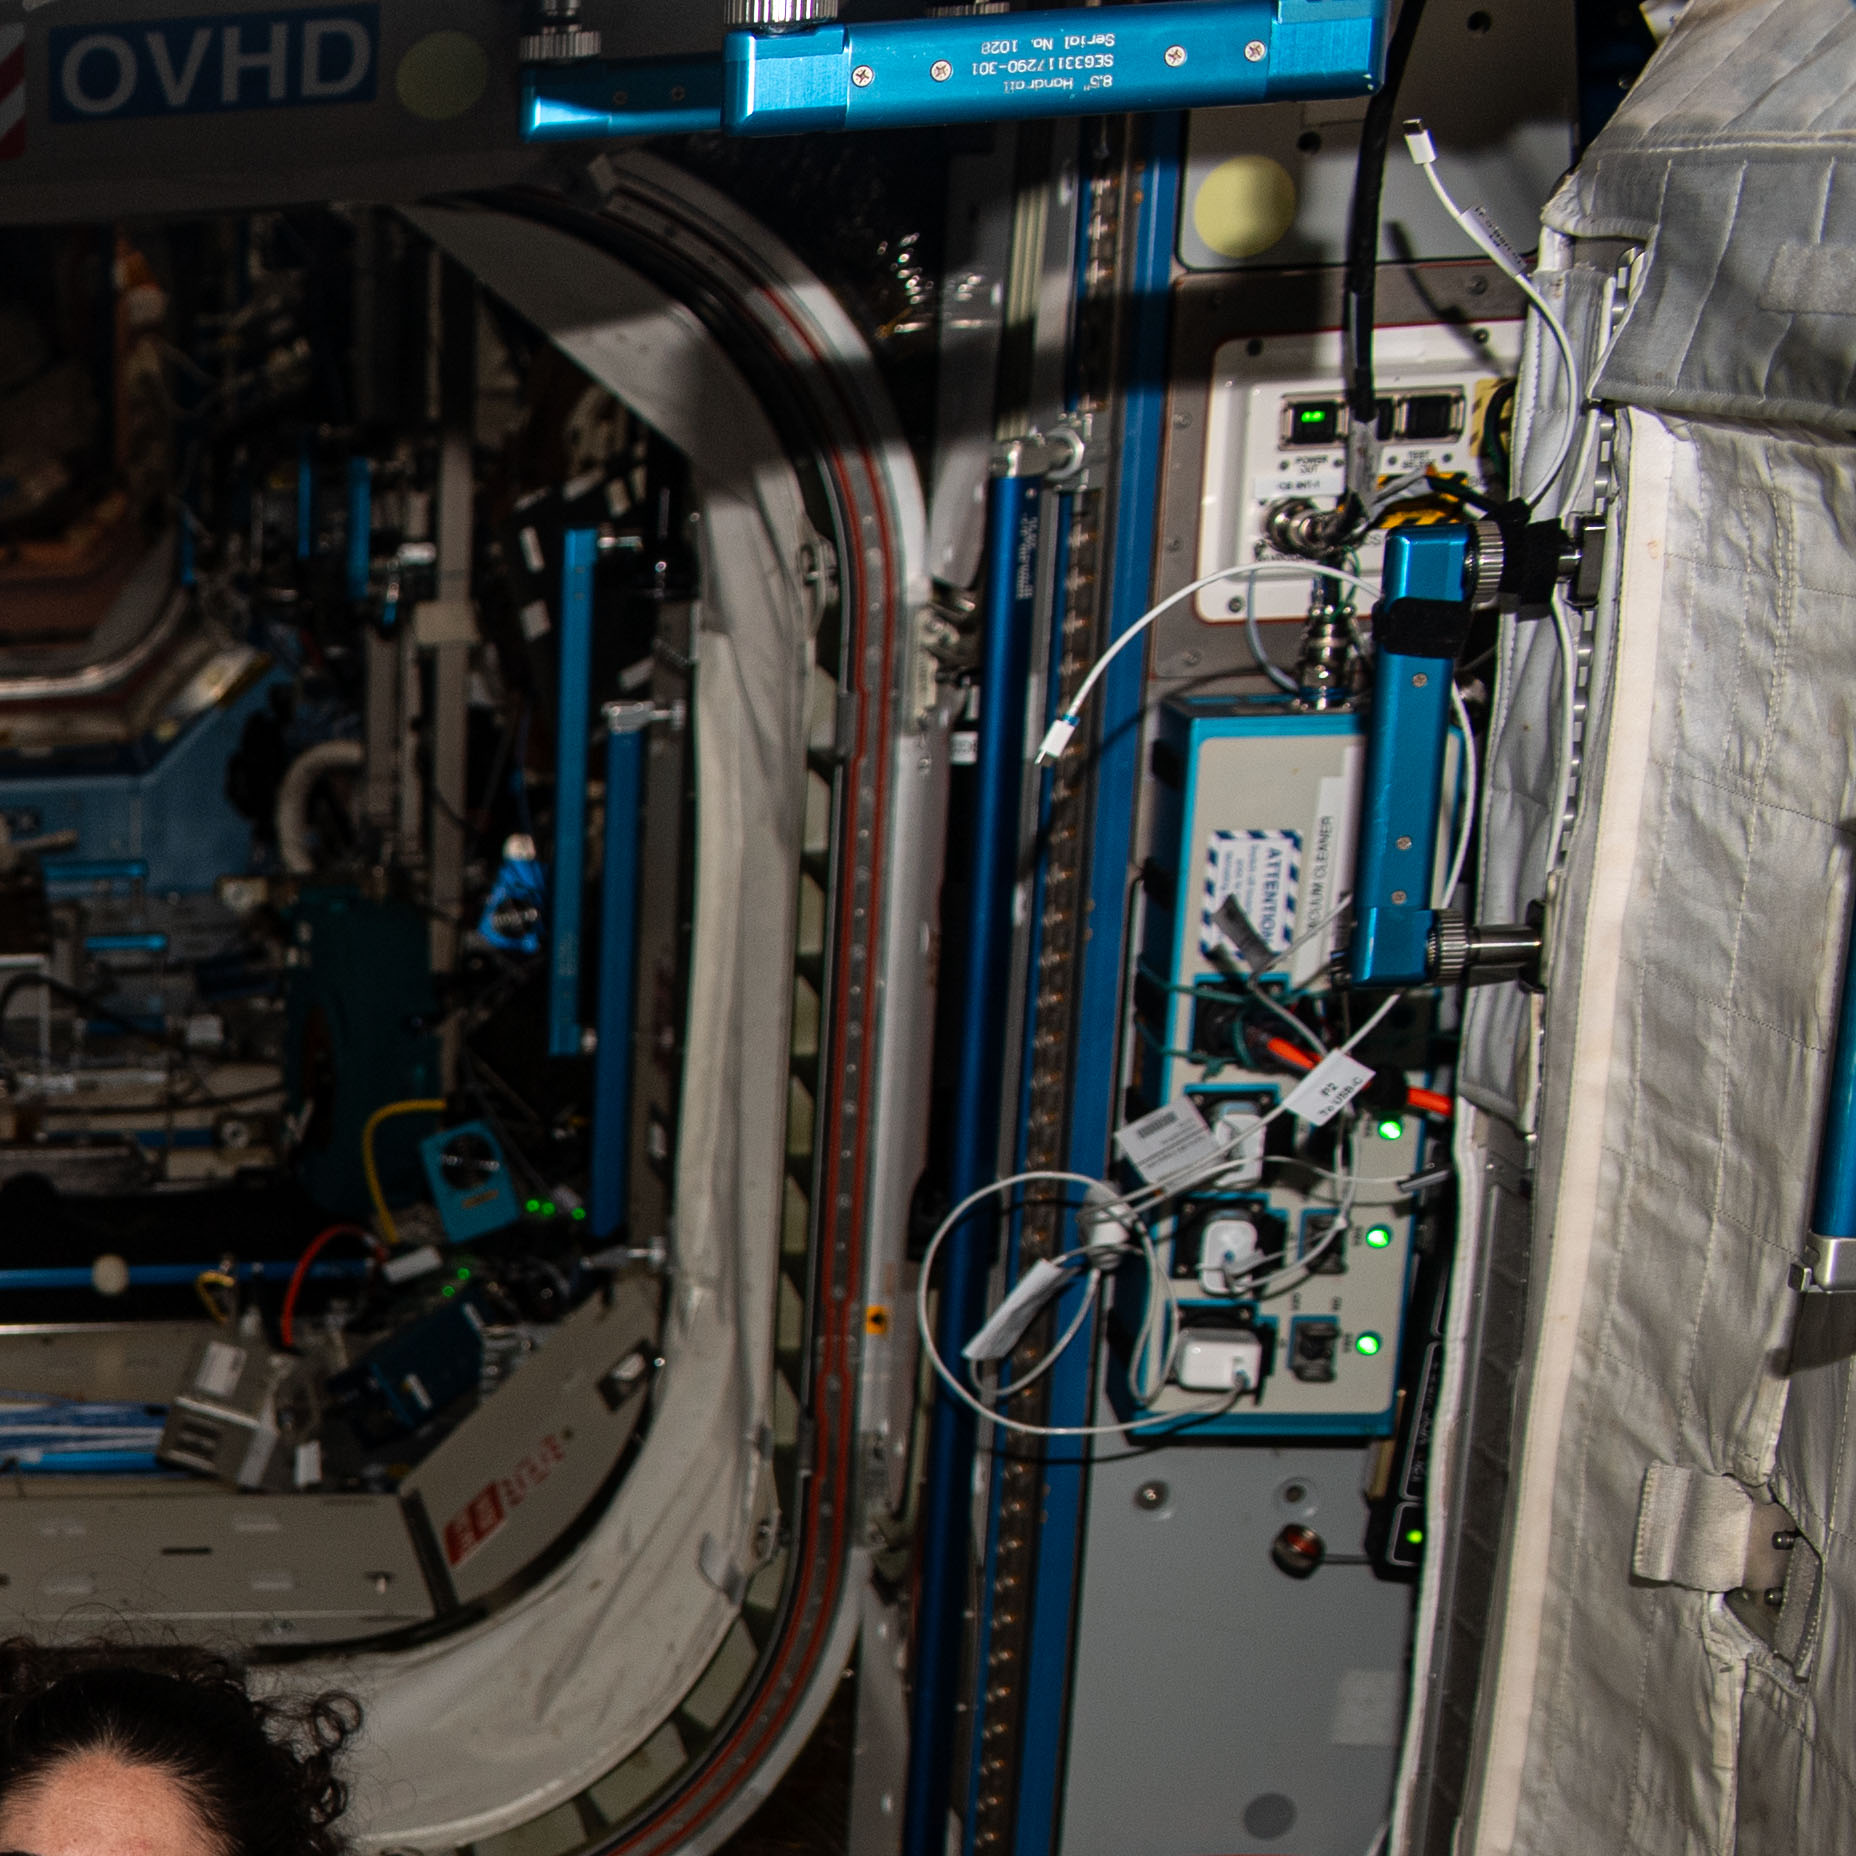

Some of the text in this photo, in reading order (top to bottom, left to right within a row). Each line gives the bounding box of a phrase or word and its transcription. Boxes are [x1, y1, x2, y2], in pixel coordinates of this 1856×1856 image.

[981, 39, 1018, 54] 1028
[1064, 34, 1115, 49] Serial
[61, 19, 371, 114] OVHD
[972, 54, 1114, 75] SEG33117290-301
[1003, 78, 1073, 94] Handrail
